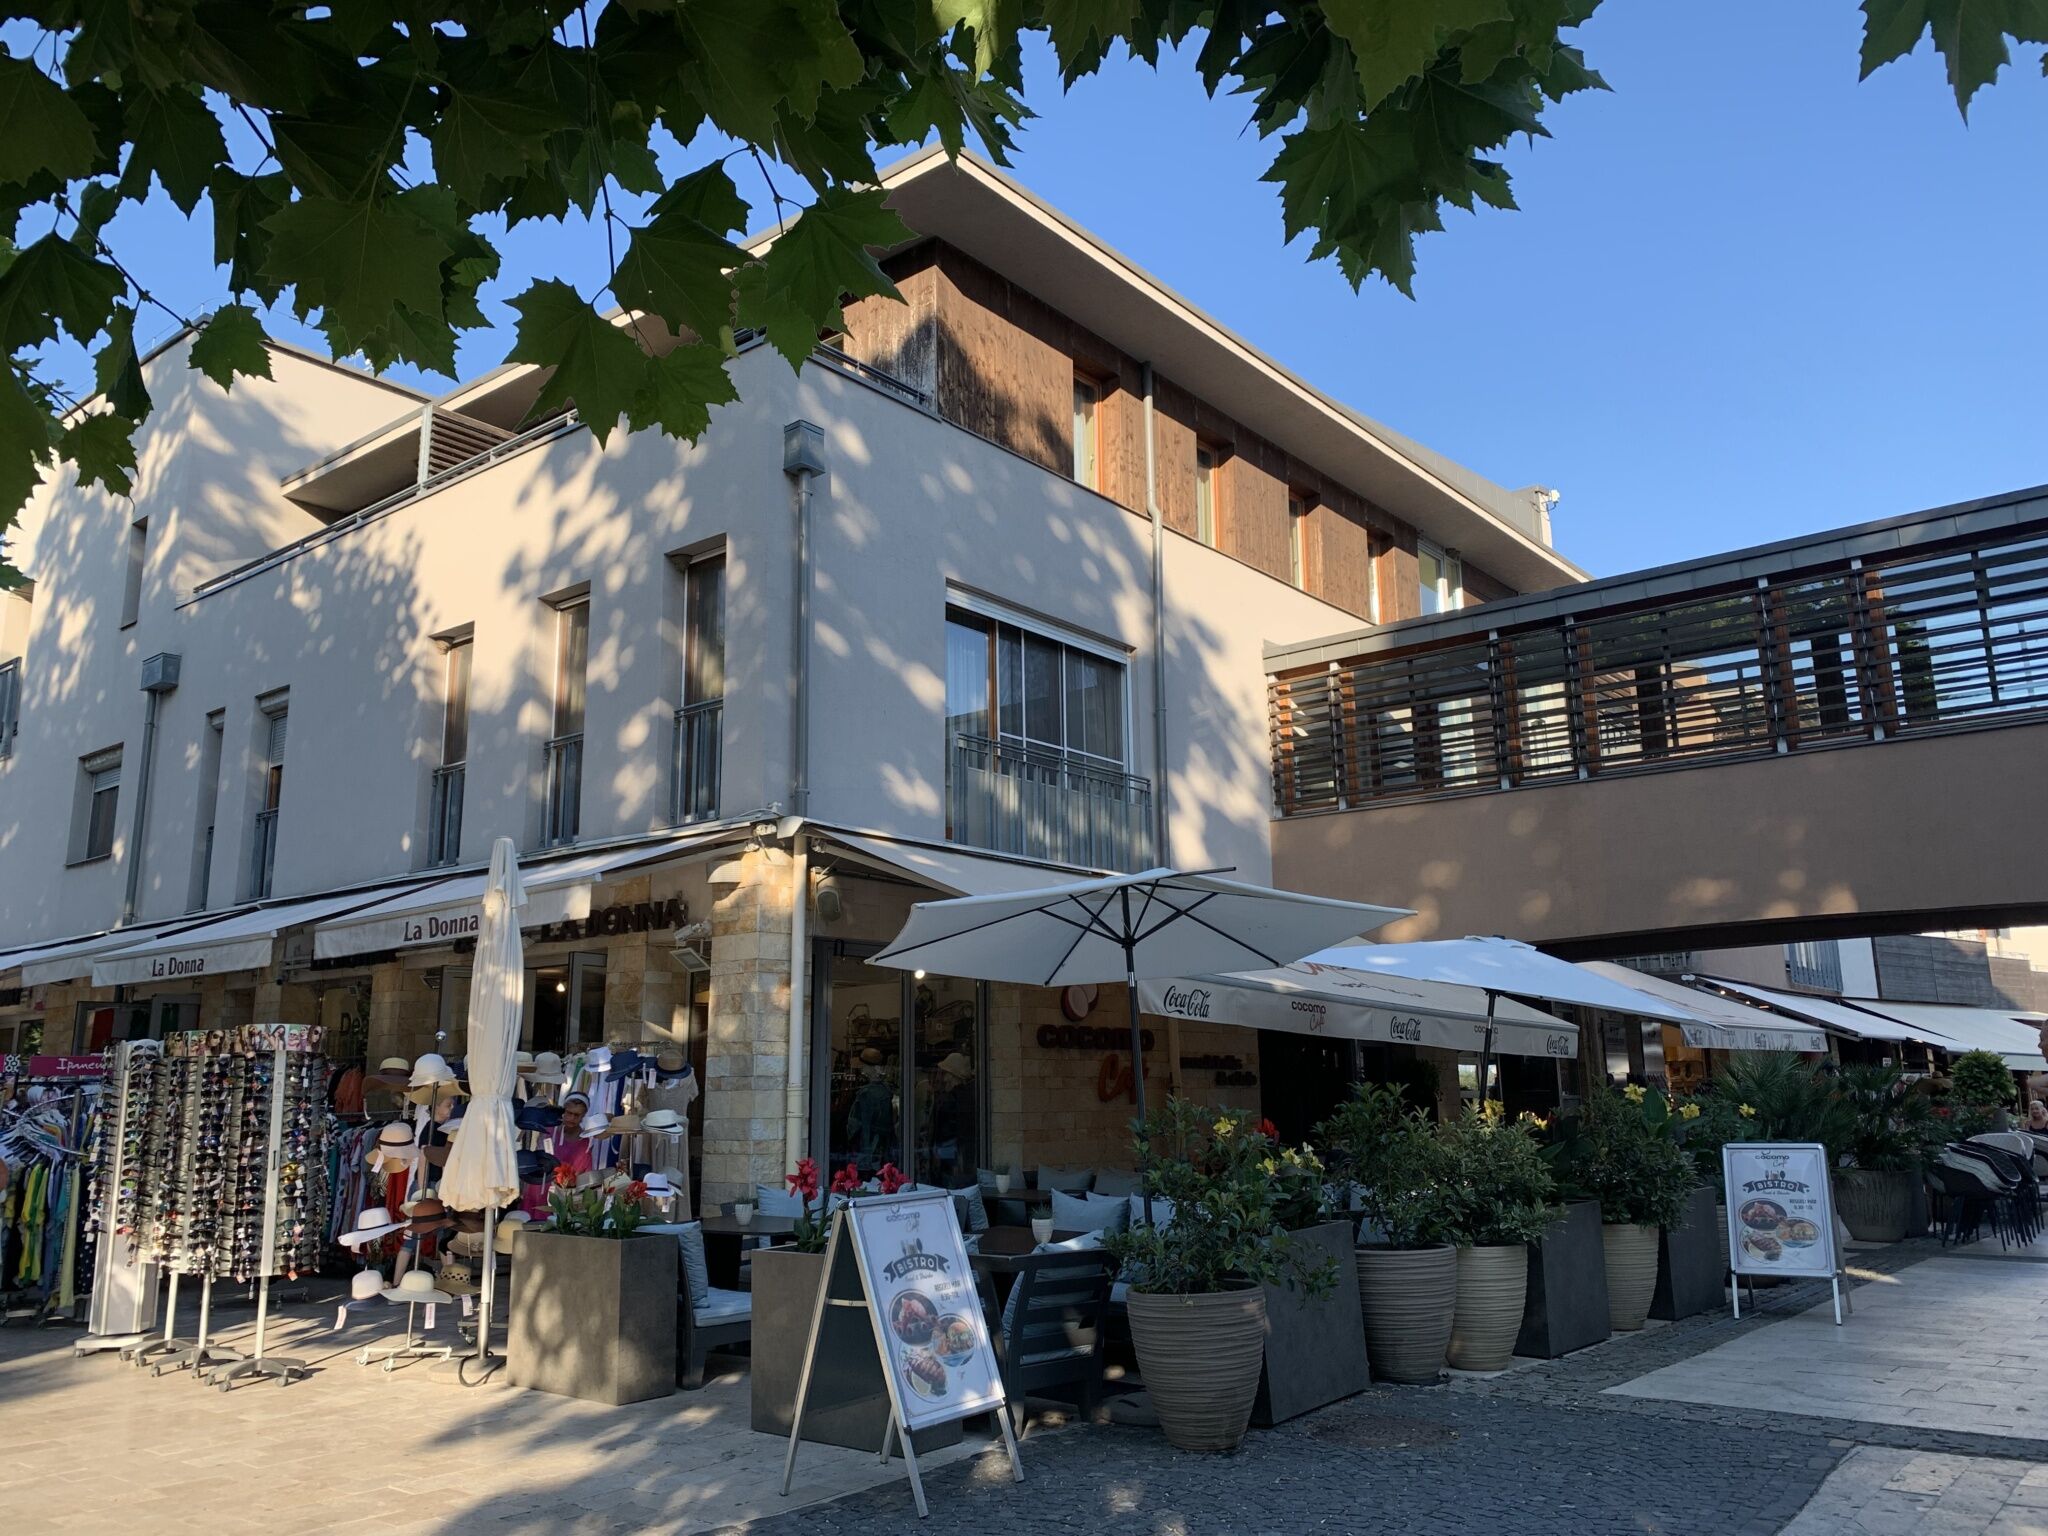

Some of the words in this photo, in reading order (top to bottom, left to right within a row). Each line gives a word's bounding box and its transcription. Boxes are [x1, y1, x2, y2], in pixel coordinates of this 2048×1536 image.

[404, 921, 423, 942] La
[429, 914, 479, 939] Donna
[585, 898, 687, 937] DONNA
[152, 959, 164, 977] La
[168, 956, 205, 976] Donna
[1757, 1180, 1795, 1190] BISTRO
[897, 1255, 936, 1274] BISTRO
